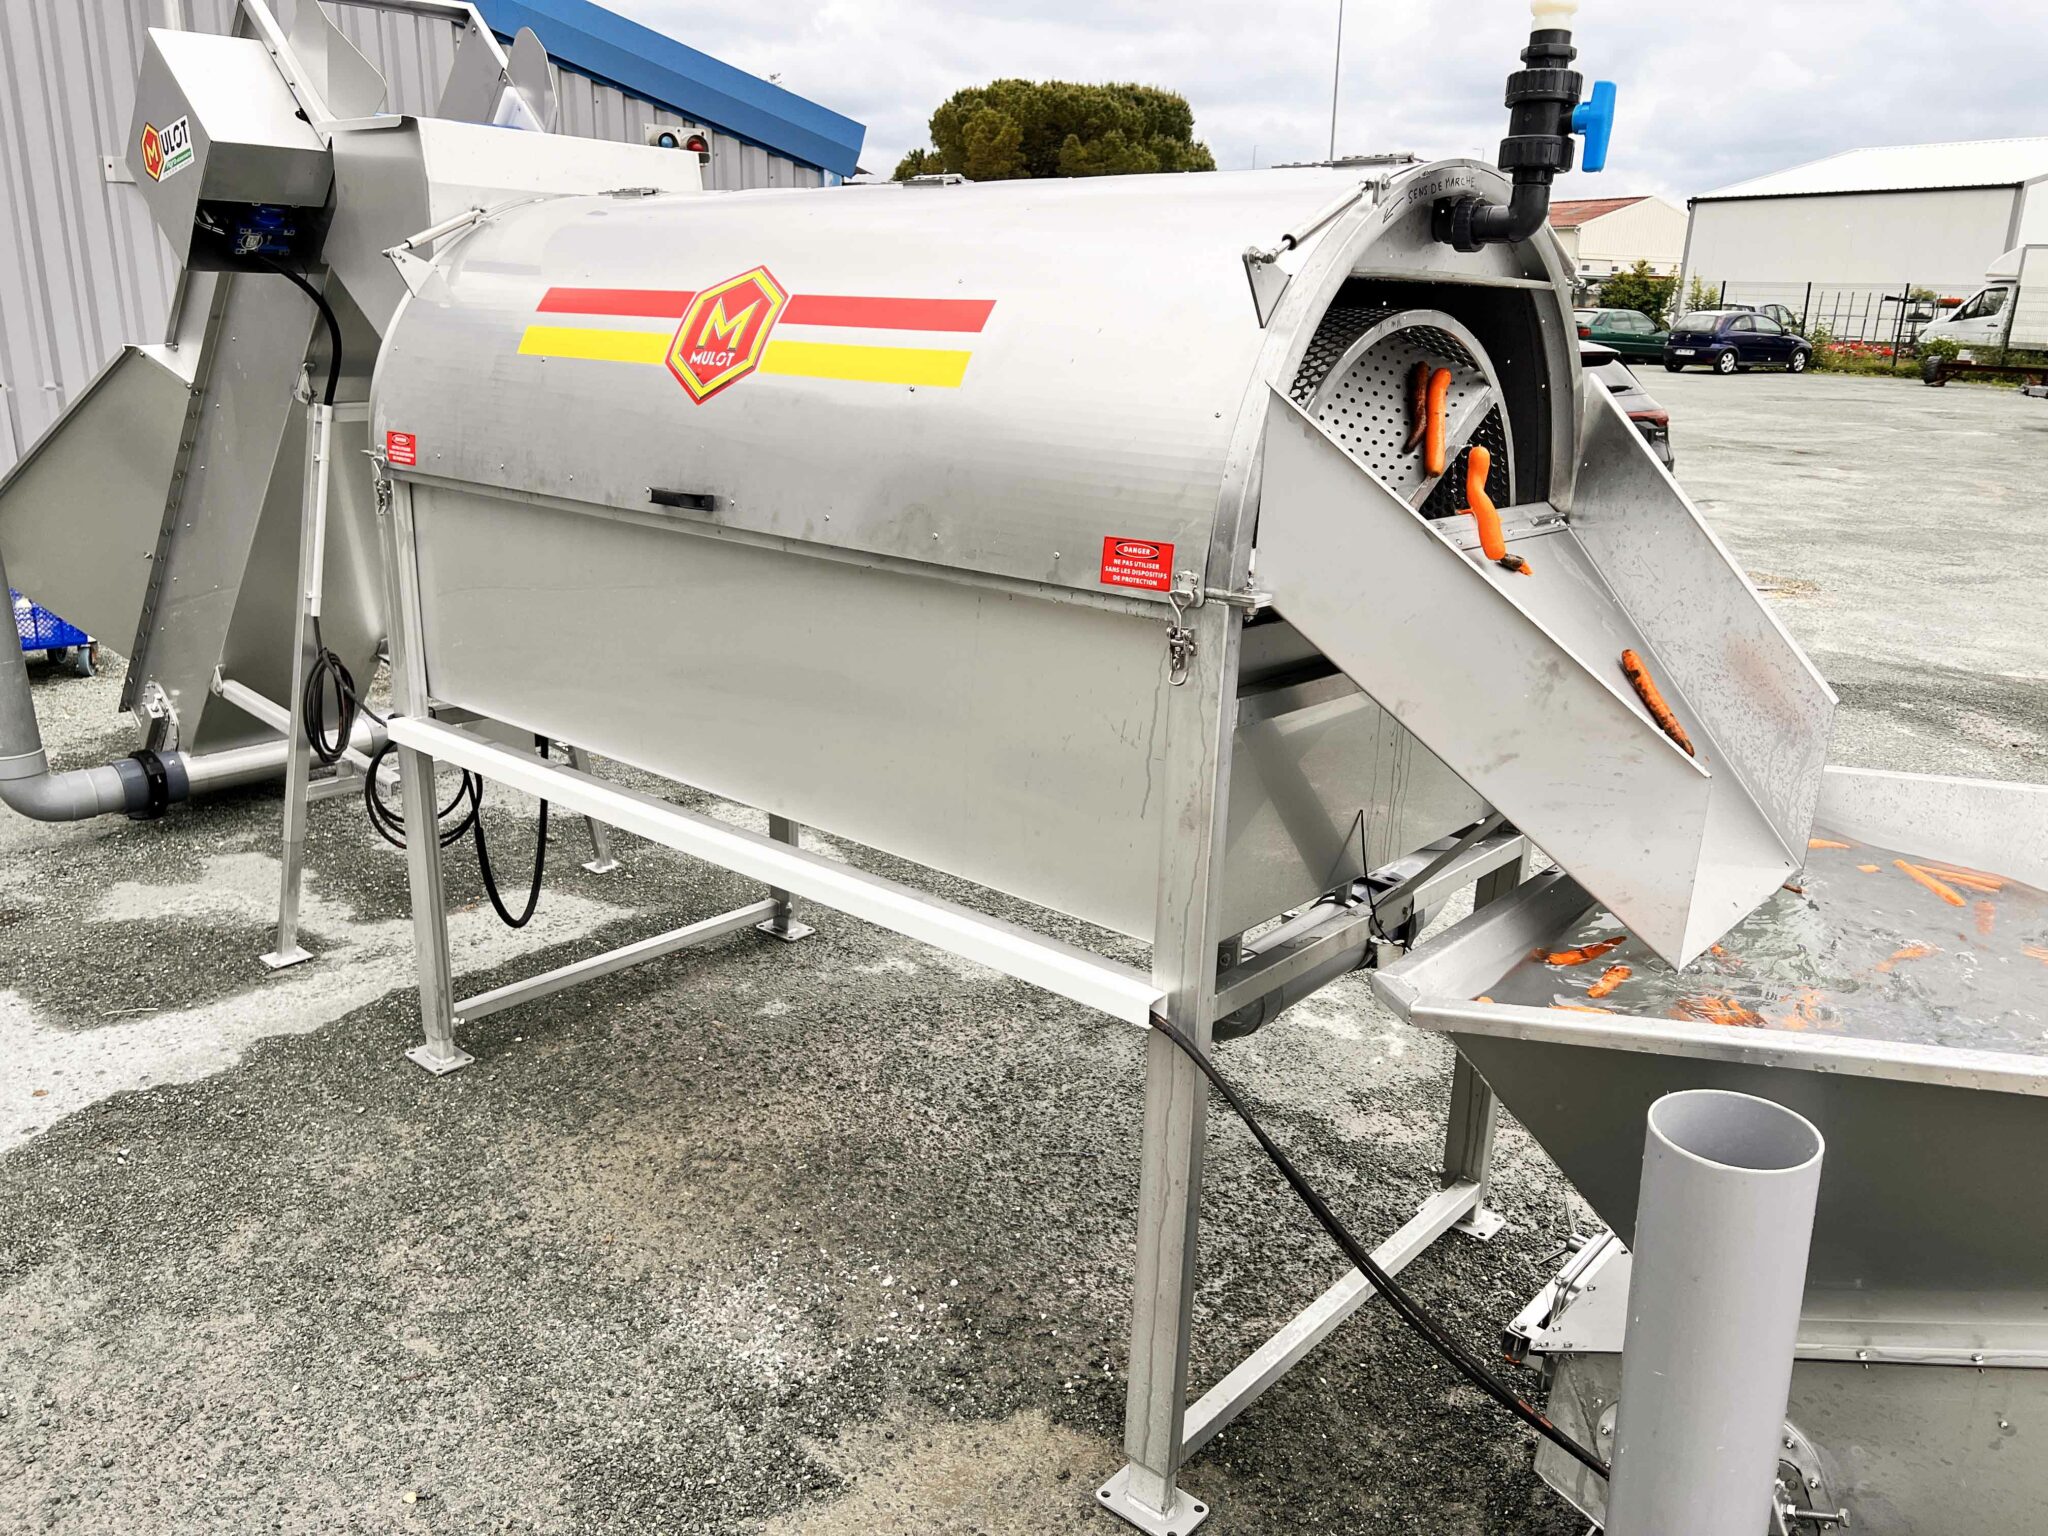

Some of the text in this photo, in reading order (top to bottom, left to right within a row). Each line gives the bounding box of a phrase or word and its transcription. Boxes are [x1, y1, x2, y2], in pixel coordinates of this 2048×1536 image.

[1408, 176, 1476, 204] SENS DE MARCHE
[695, 296, 763, 351] M
[689, 351, 735, 367] MULOT
[1123, 546, 1151, 555] DANGER
[1122, 559, 1133, 567] PAS
[1134, 561, 1160, 569] UTILISER
[1131, 569, 1168, 579] DISPOSITIFS
[1122, 576, 1158, 586] PROTECTION
